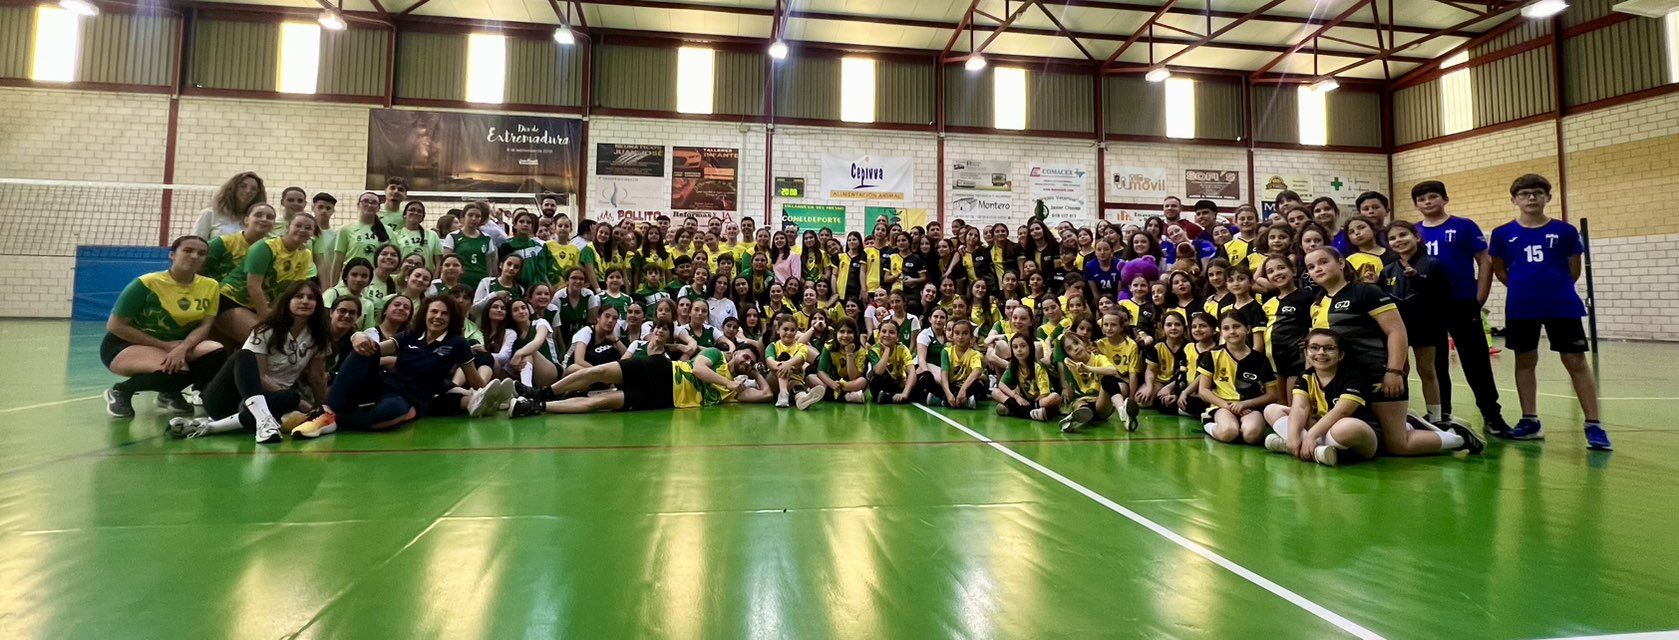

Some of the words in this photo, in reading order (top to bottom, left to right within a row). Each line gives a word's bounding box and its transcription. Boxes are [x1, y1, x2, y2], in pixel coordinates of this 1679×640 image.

[487, 127, 569, 145] Extremadura
[850, 163, 884, 184] Cepivva
[978, 200, 1010, 210] Montero
[617, 210, 662, 221] POLLITO
[1425, 240, 1439, 256] 11
[1523, 244, 1544, 263] 15
[1100, 279, 1112, 289] 24
[194, 298, 210, 311] 20
